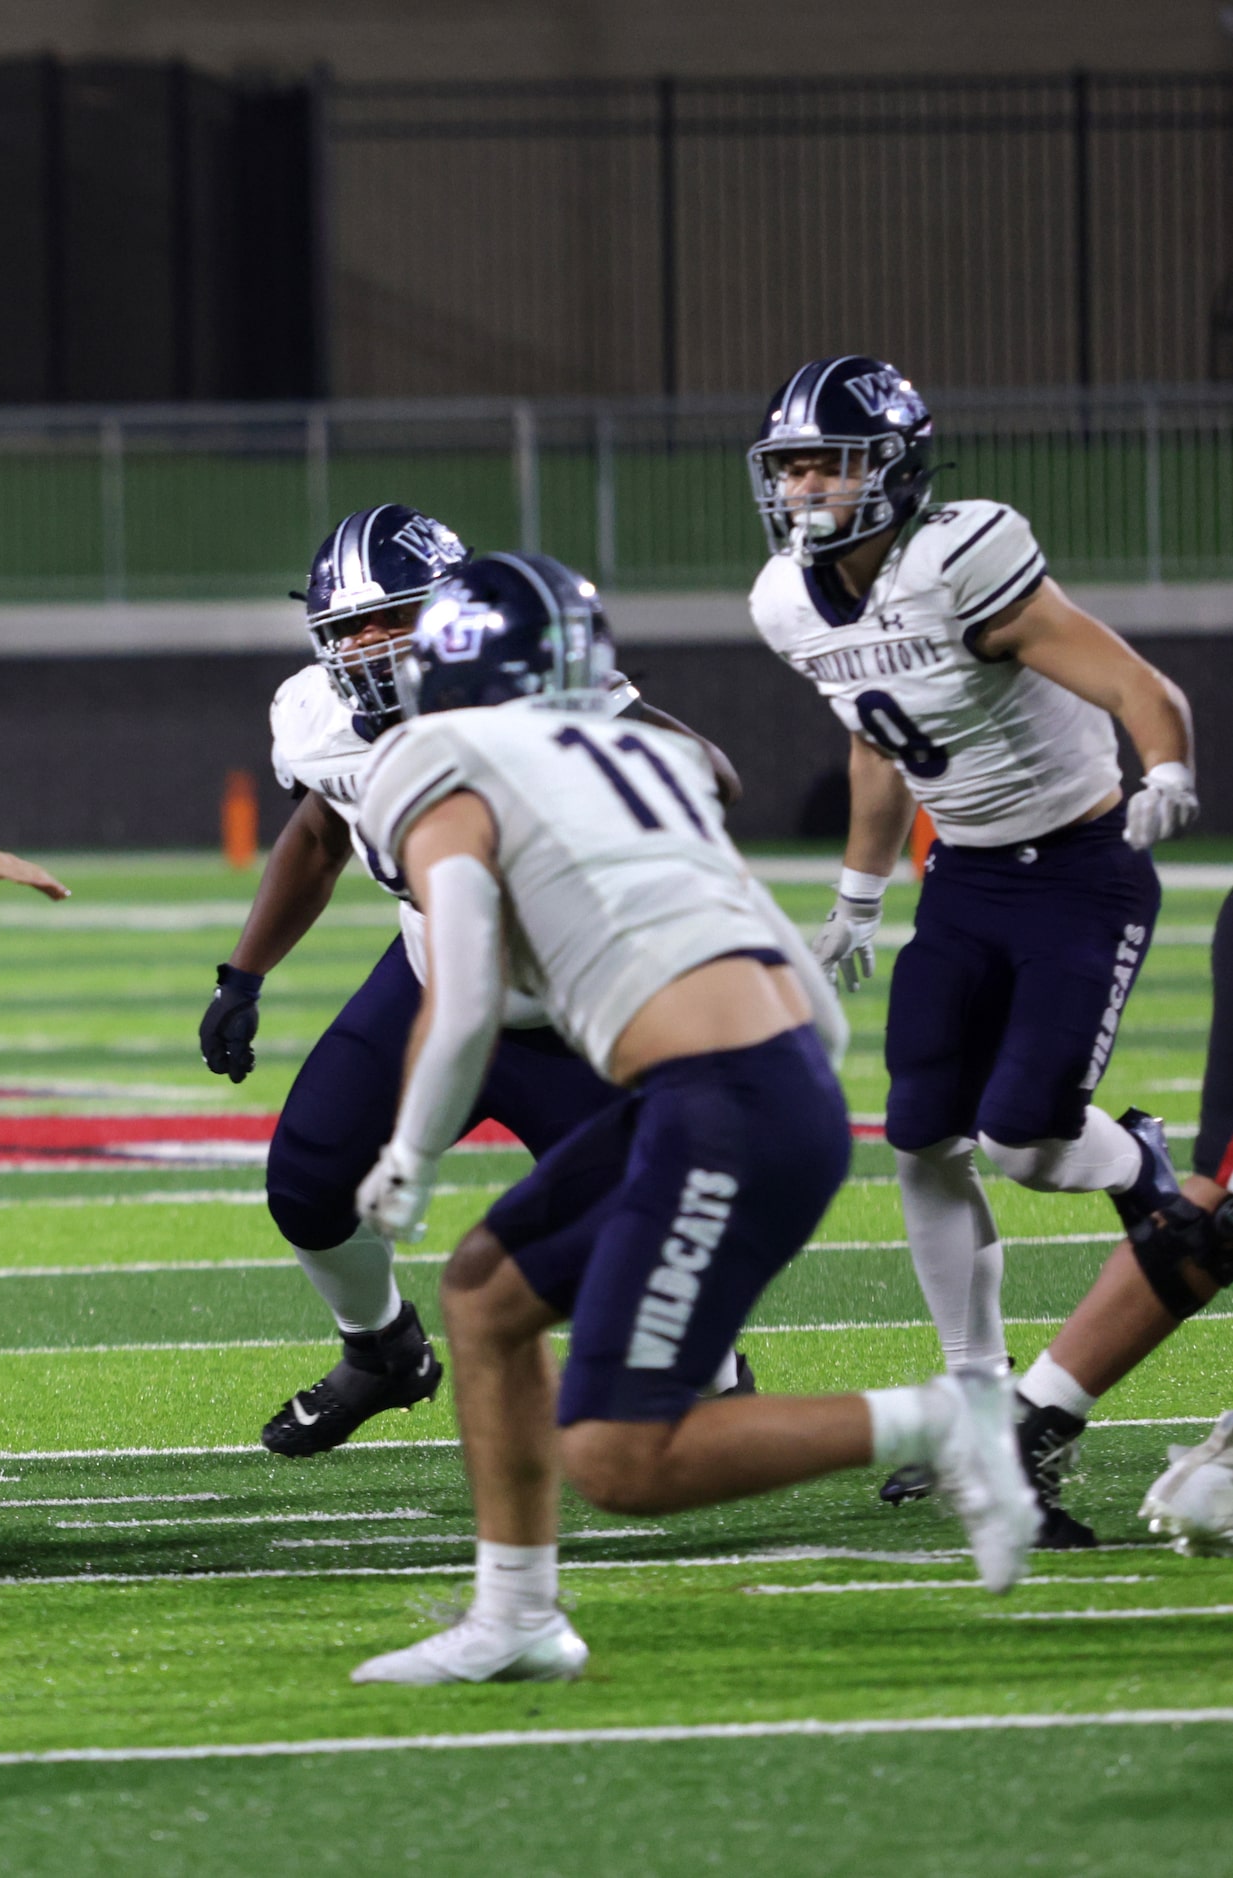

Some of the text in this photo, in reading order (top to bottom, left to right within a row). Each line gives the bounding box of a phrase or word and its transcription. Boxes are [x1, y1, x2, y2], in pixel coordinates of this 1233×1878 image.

[552, 727, 711, 842] 11
[1078, 923, 1146, 1090] WILDCATS
[625, 1168, 739, 1369] WILDCATS
